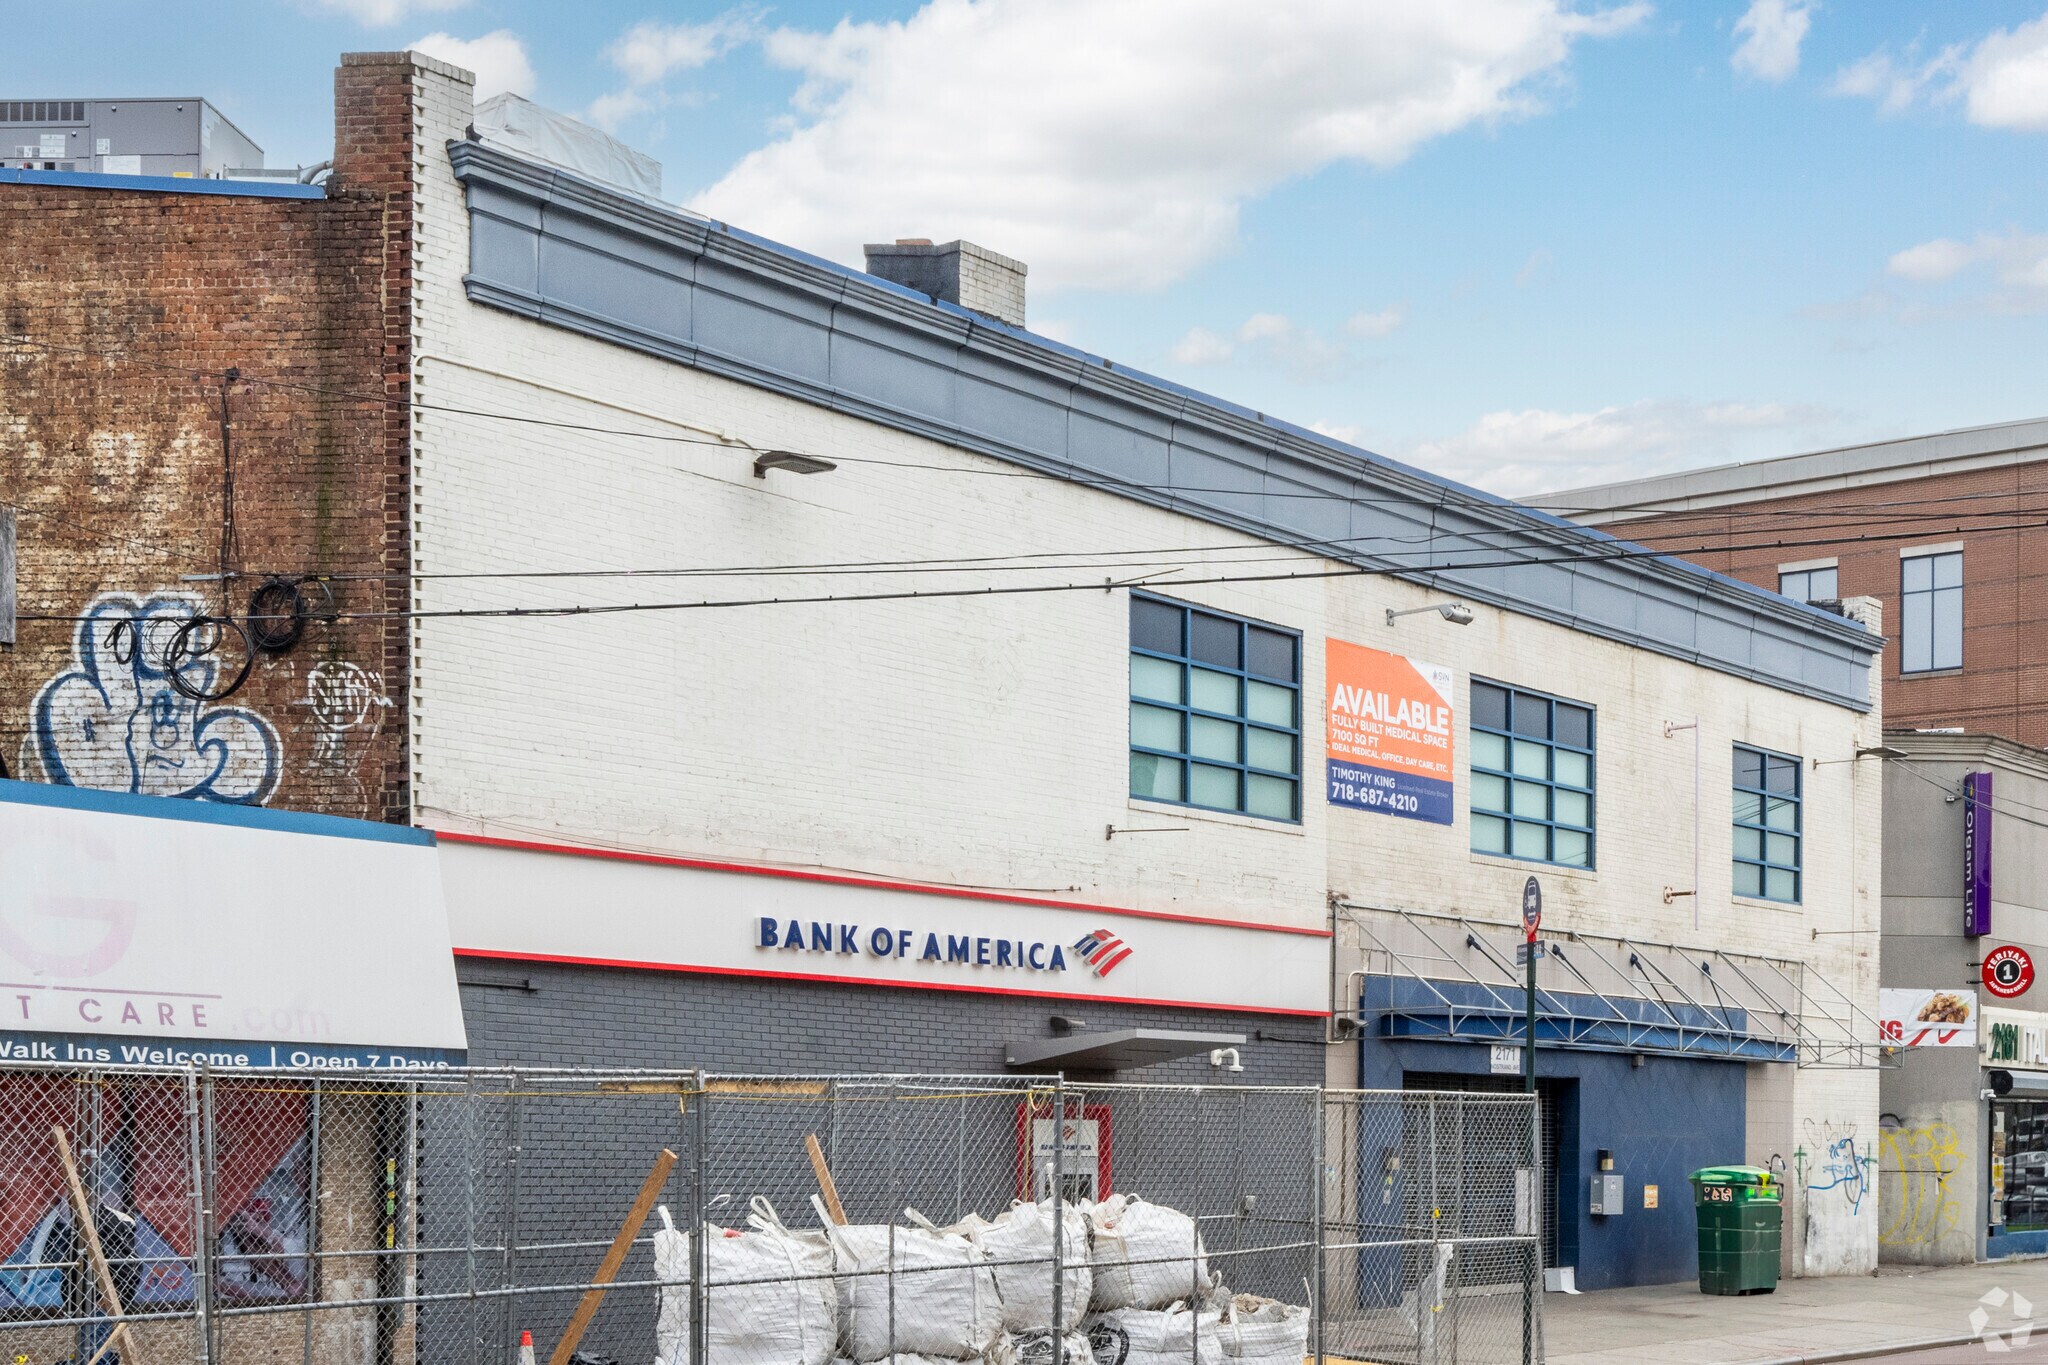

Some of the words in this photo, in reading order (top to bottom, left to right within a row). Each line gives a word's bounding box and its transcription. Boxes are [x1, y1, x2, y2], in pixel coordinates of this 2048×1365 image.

[1331, 683, 1449, 736] AVAILABLE
[1331, 713, 1359, 728] FULLY
[1360, 720, 1383, 735] BUILT
[1385, 726, 1421, 743] MEDICAL
[1423, 734, 1448, 749] SPACE
[1332, 728, 1353, 742] 7100
[1354, 733, 1367, 746] SQ
[1368, 735, 1379, 747] FT
[1332, 742, 1350, 753] IDEAL
[1352, 745, 1380, 760] MEDICAL,
[1382, 752, 1405, 765] OFFICE,
[1405, 756, 1418, 766] DAY
[1418, 759, 1436, 771] CARE,
[1436, 762, 1448, 773] ETC.
[1332, 766, 1372, 784] TIMOTHY
[1374, 773, 1396, 789] KING
[1332, 782, 1418, 812] 718-687-4210
[1965, 811, 1974, 882] Olgam
[1965, 889, 1973, 928] Life
[759, 917, 859, 954] BANK
[870, 927, 913, 957] OF
[921, 932, 1067, 971] AMERICA
[1987, 951, 2028, 969] TERIYAKI
[2003, 964, 2013, 980] 1
[1989, 981, 2014, 994] JAPANESE
[2013, 979, 2027, 991] GRILL
[78, 998, 208, 1028] CARE
[67, 1043, 111, 1061] Ins
[120, 1046, 249, 1067] Welcome
[290, 1051, 358, 1069] Open
[367, 1055, 381, 1068] 7
[390, 1055, 449, 1069] Days
[1495, 1046, 1515, 1061] 2171
